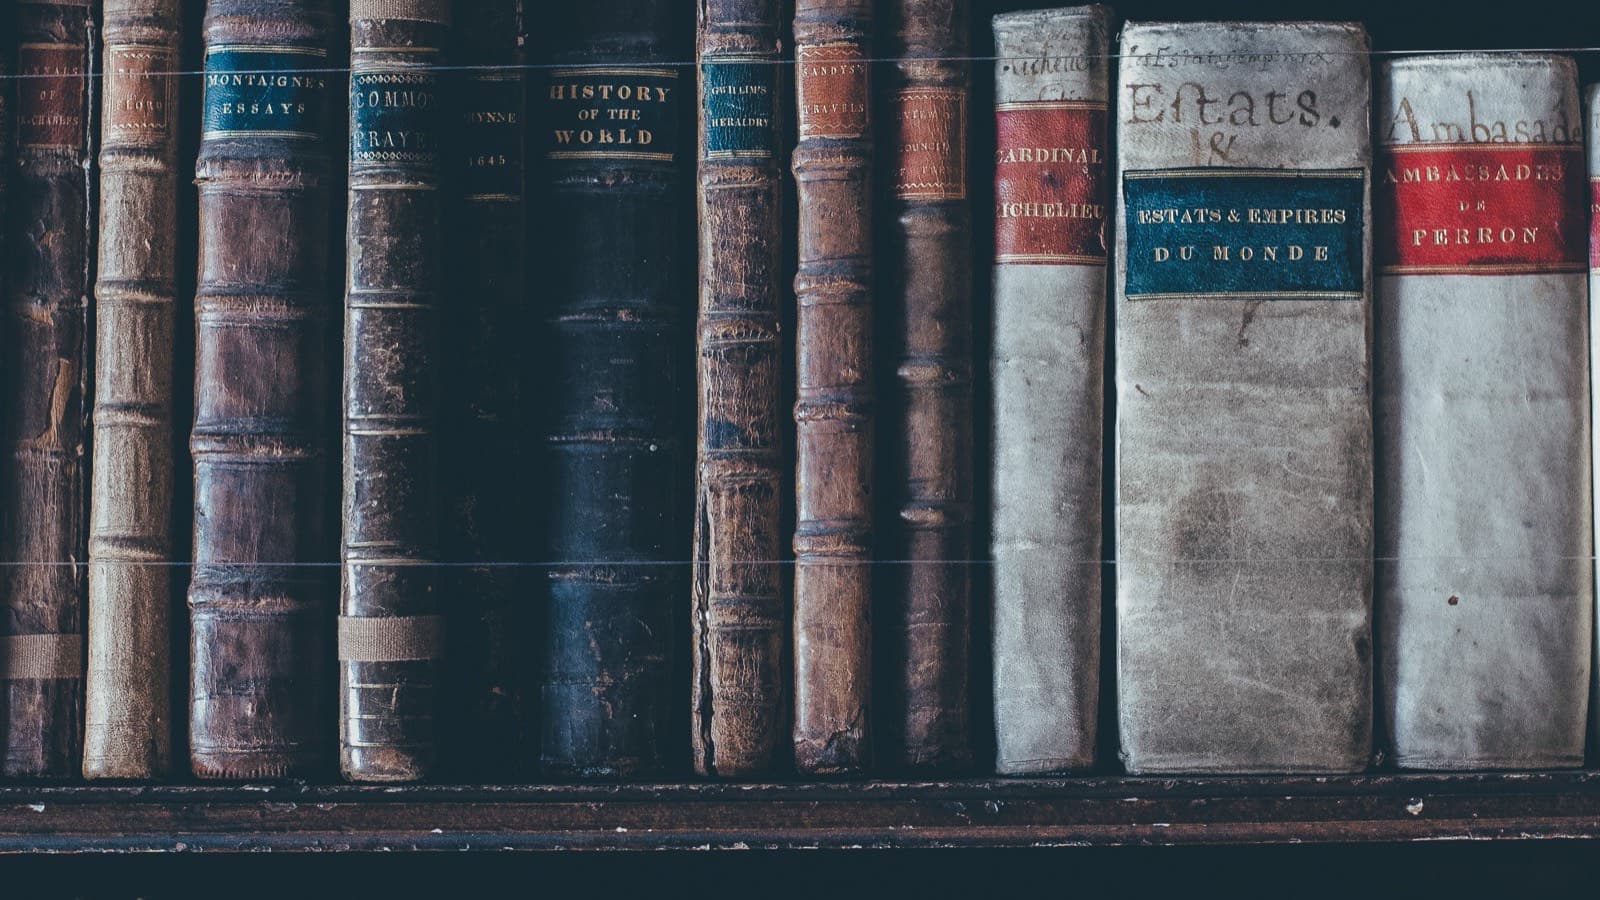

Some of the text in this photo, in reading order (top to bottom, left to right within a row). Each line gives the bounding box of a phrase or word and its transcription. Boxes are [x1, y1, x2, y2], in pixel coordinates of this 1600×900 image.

[207, 75, 326, 89] MONTAIGNES
[356, 91, 434, 108] COMMO
[549, 84, 670, 103] HISTORY
[222, 103, 306, 115] ESSAYS
[577, 109, 641, 121] OF THE
[803, 103, 865, 115] TRAVELS
[711, 117, 769, 128] HERALDRY
[554, 129, 653, 145] WORLD
[995, 202, 1104, 218] ICHELIEU
[1459, 200, 1486, 212] DE
[1137, 208, 1346, 224] ESTATS & EMPIRES
[1412, 227, 1538, 246] PERRON
[1153, 246, 1329, 262] DU MONDE
